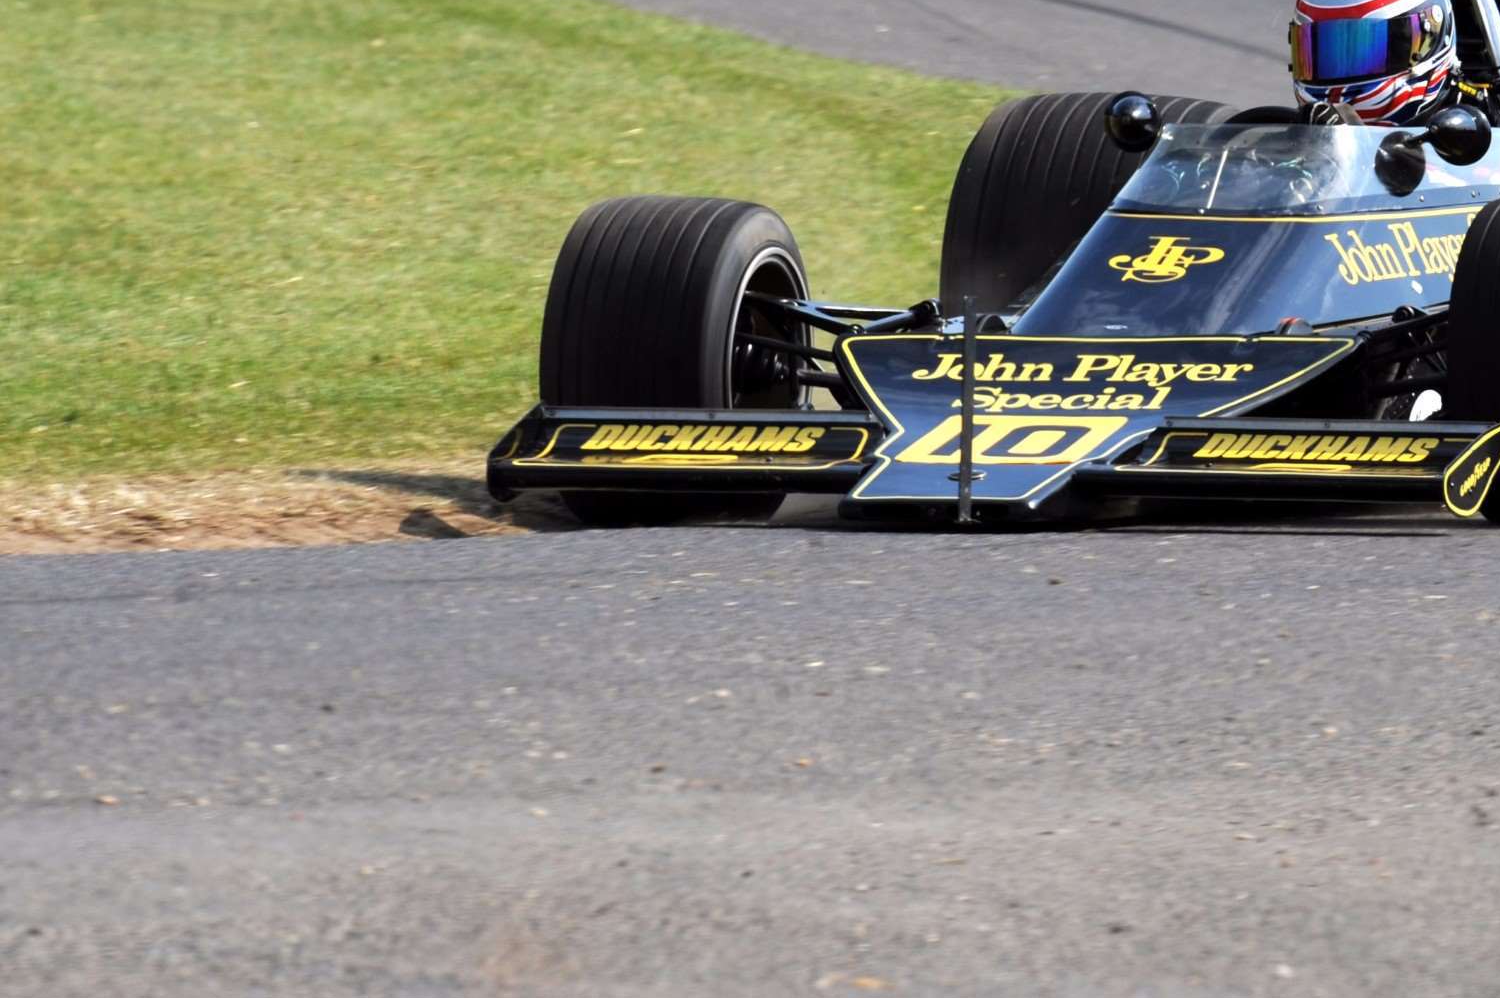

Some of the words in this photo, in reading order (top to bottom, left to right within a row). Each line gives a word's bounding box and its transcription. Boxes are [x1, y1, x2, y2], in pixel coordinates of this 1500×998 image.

[1324, 228, 1408, 286] John
[911, 353, 1054, 382] John
[1062, 353, 1254, 388] Player
[951, 386, 1173, 413] Special
[580, 424, 827, 454] DUCKHAMS
[1193, 432, 1441, 463] DUCKHAMS
